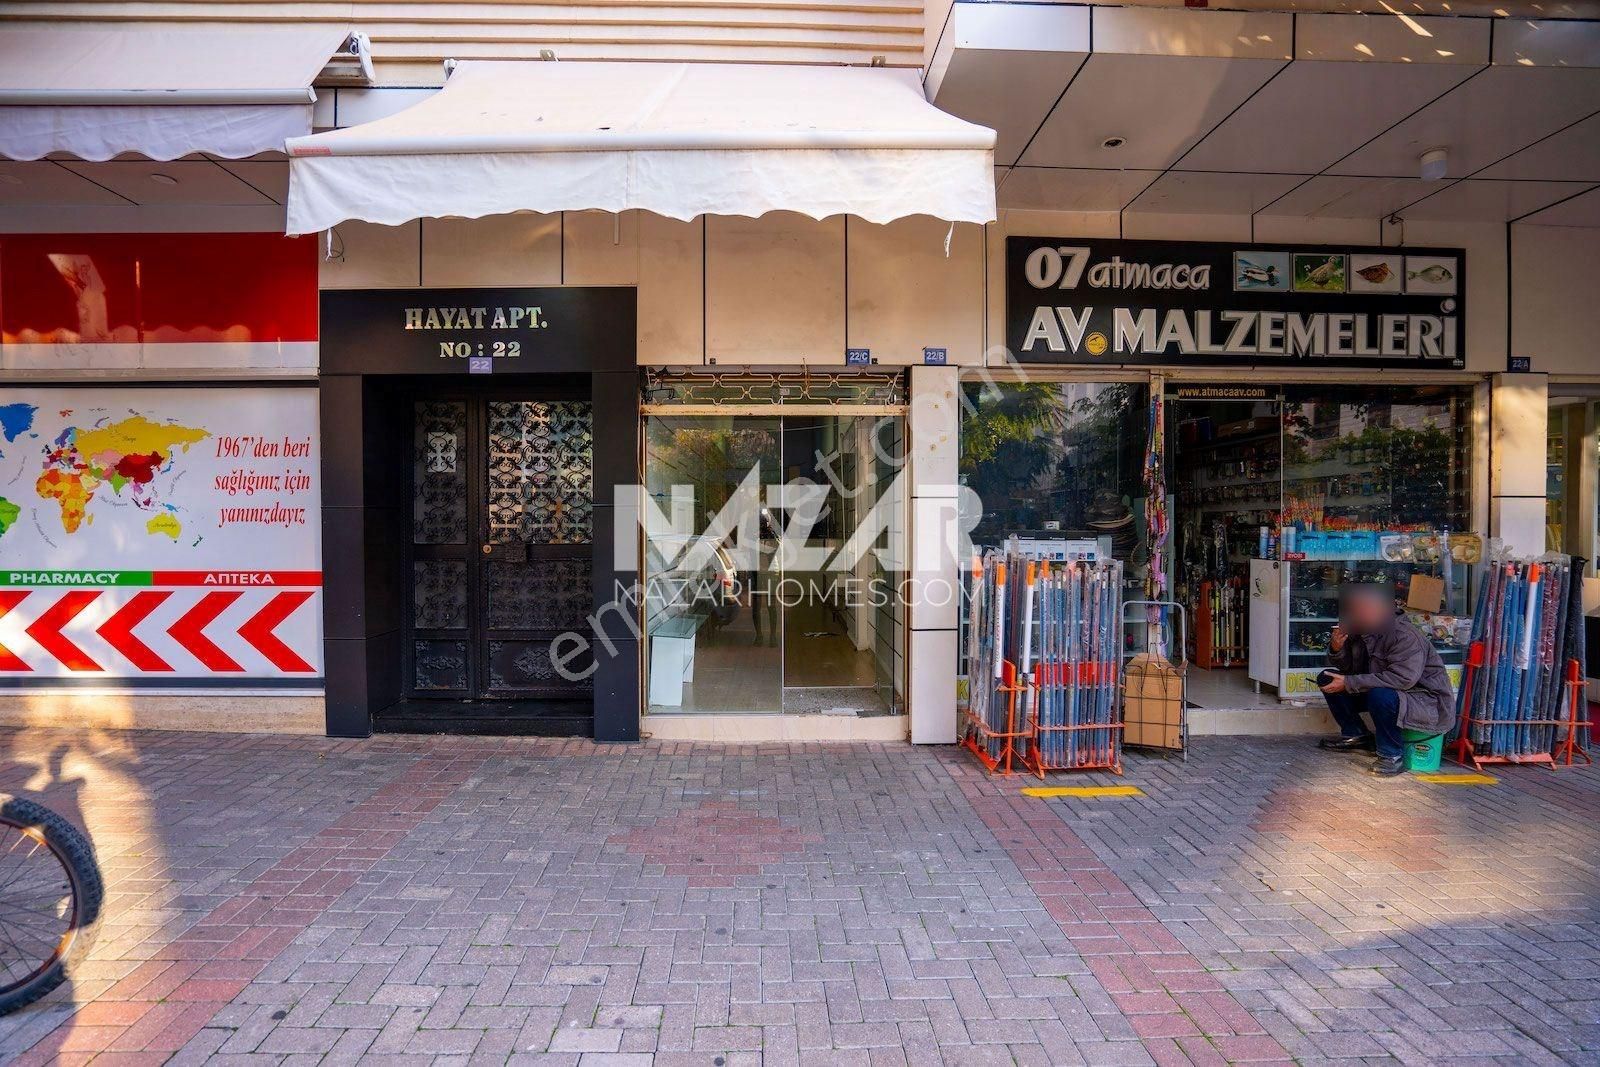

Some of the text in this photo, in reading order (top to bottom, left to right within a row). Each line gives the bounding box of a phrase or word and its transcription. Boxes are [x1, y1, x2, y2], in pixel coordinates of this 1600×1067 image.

[1025, 246, 1212, 291] 07 atmaca
[404, 306, 549, 330] HAYAT APT.
[492, 341, 521, 358] 22
[849, 351, 868, 361] 22/C
[926, 351, 945, 360] 22/B
[471, 360, 490, 370] 22
[1177, 387, 1266, 397] www.atmacaav.com
[283, 436, 311, 458] beri
[215, 469, 280, 496] sağlığınız
[284, 469, 311, 496] için
[218, 501, 306, 528] yanınızdayız
[9, 573, 120, 584] PHARMACY
[203, 573, 276, 585] АПТЕКА
